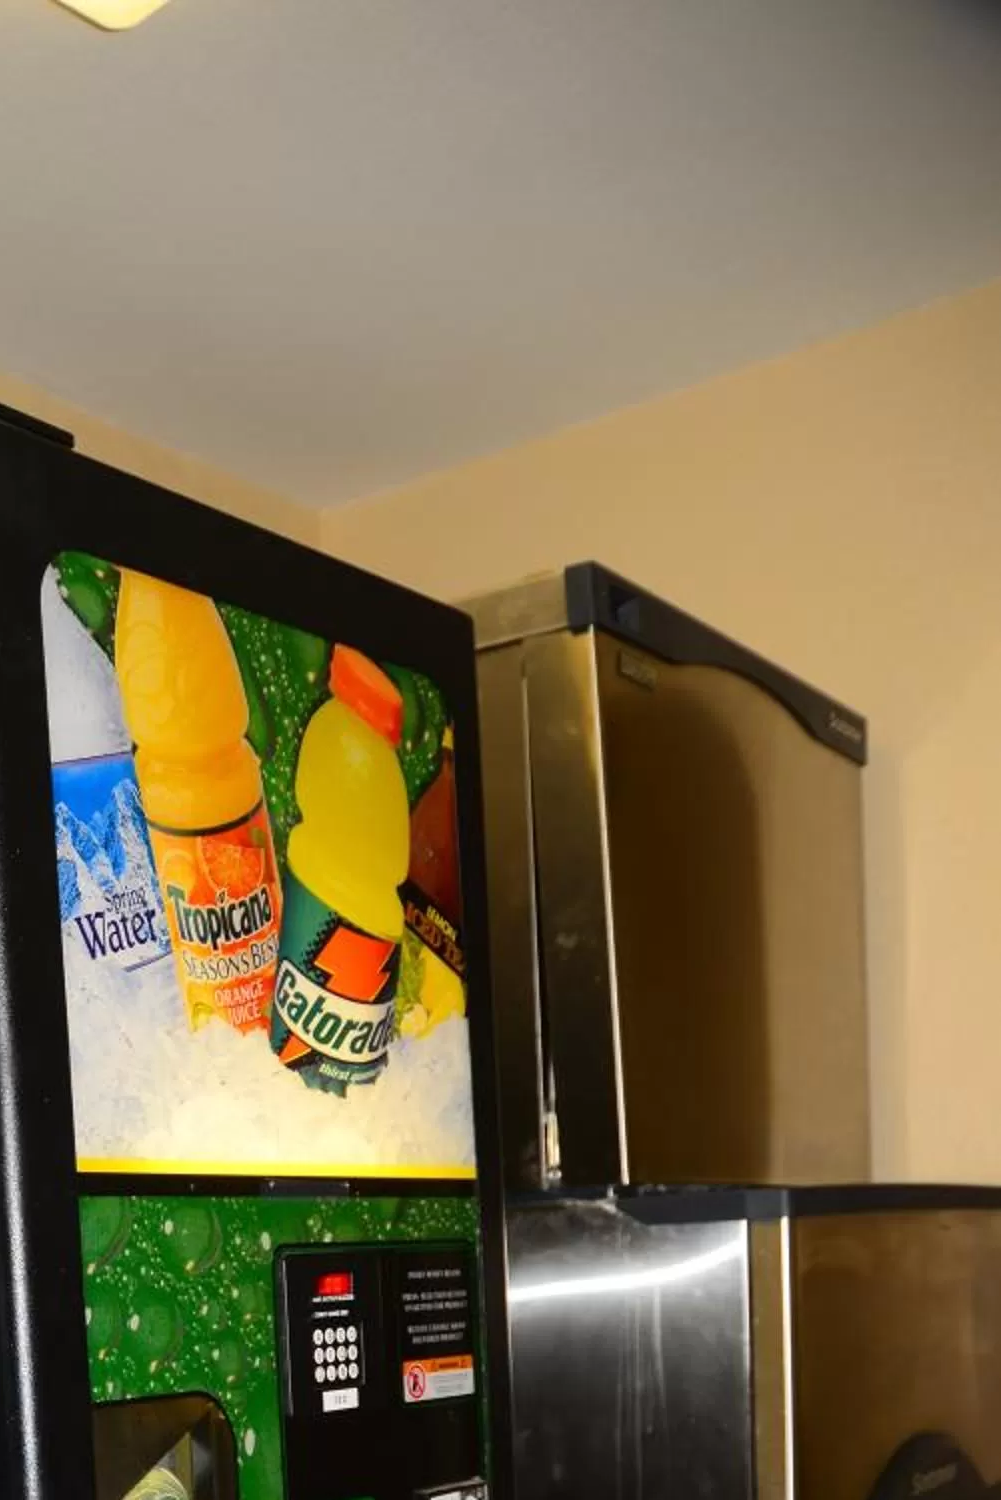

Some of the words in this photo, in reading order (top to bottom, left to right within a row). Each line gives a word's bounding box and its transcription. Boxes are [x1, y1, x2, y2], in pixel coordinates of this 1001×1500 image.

[104, 885, 147, 914] Spring
[167, 884, 273, 950] Tropicana
[75, 909, 158, 959] Water
[215, 979, 264, 1007] ORANGE
[229, 1002, 262, 1027] JUICE
